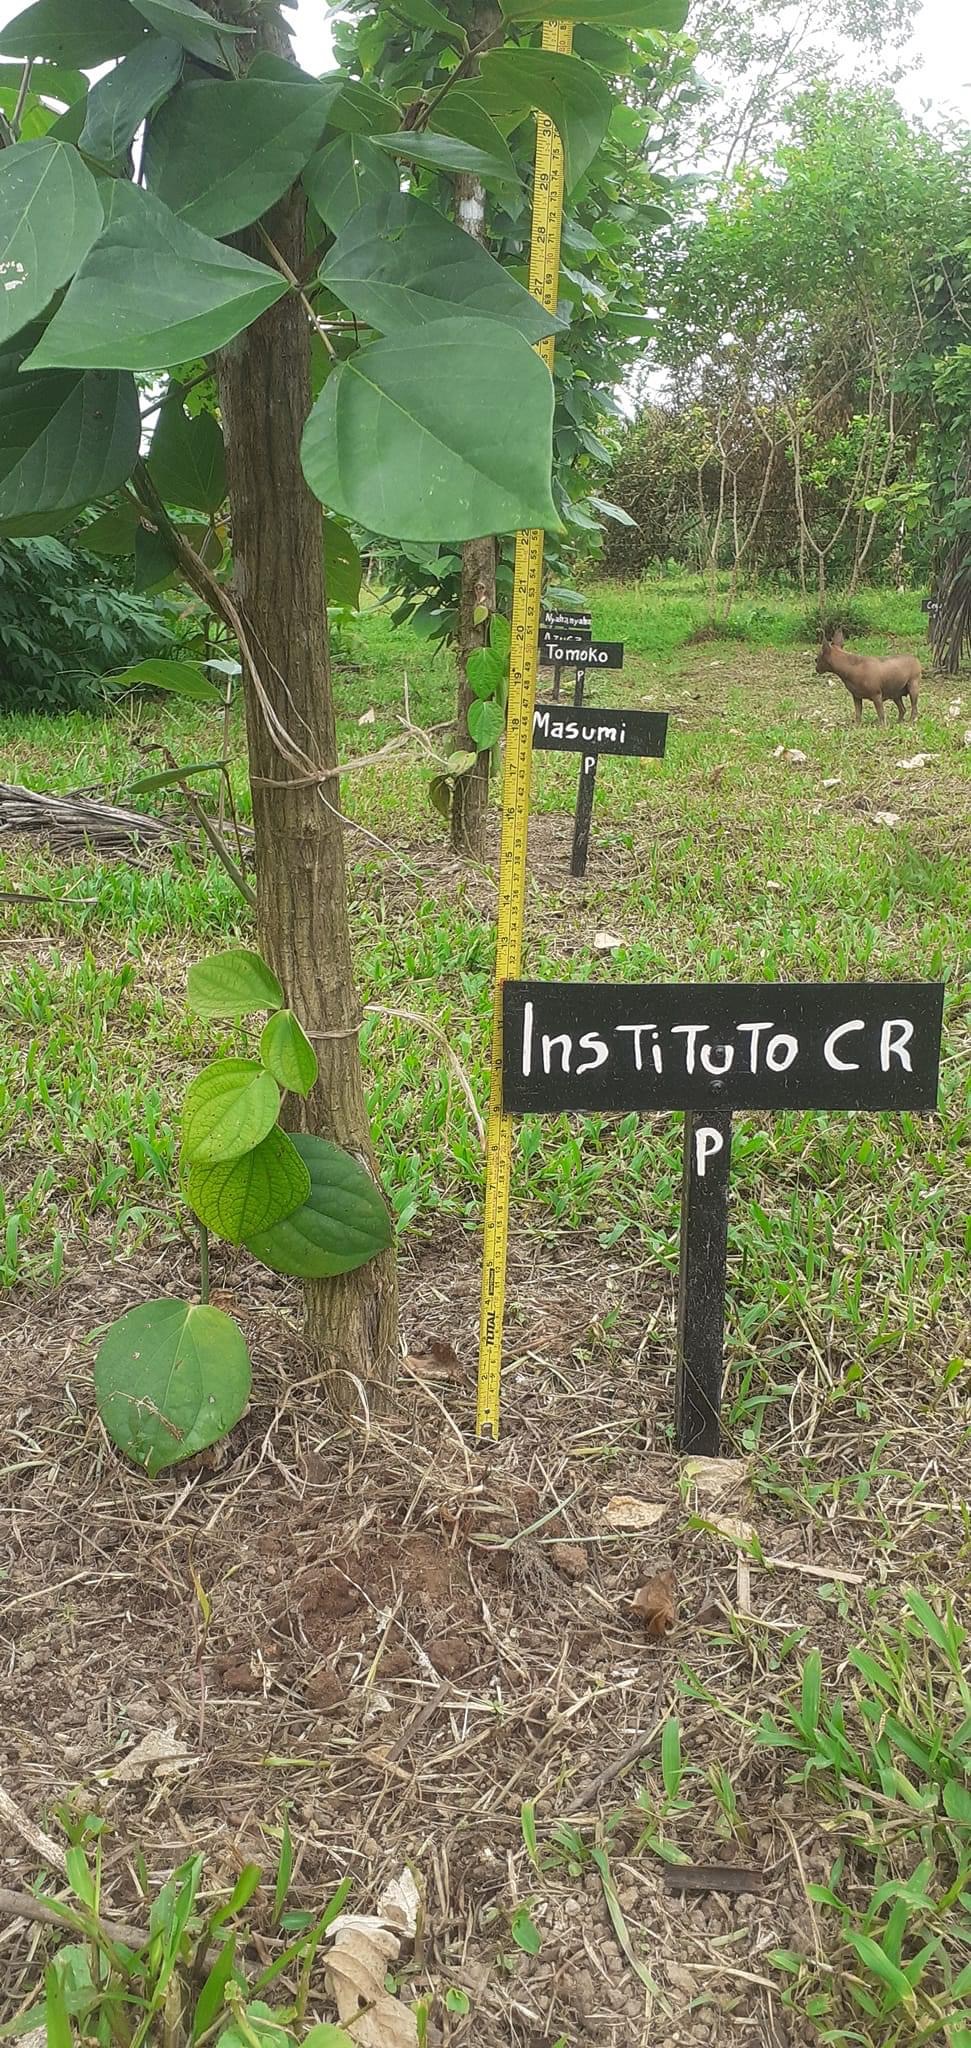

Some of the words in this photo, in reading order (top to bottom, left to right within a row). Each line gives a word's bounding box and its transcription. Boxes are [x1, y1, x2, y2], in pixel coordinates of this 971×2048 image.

[543, 119, 551, 137] 30
[552, 149, 559, 160] 75
[552, 170, 558, 181] 74
[540, 173, 549, 191] 29
[550, 192, 557, 202] 73
[549, 212, 556, 222] 72
[537, 226, 545, 243] 28
[548, 233, 555, 243] 71
[546, 274, 553, 284] 69
[535, 279, 543, 295] 27
[544, 294, 551, 304] 68
[521, 529, 529, 545] 22
[532, 530, 538, 540] 56
[531, 550, 537, 559] 55
[530, 569, 536, 579] 54
[519, 580, 526, 593] 21
[529, 588, 535, 597] 53
[528, 606, 534, 616] 52
[516, 625, 524, 640] 20
[527, 625, 533, 635] 51
[525, 662, 531, 672] 49
[514, 672, 521, 684] 19
[577, 670, 584, 682] P
[524, 680, 530, 690] 48
[523, 699, 529, 708] 47
[512, 718, 519, 731] 18
[522, 716, 528, 726] 46
[533, 711, 626, 743] Masumi
[521, 734, 527, 744] 45
[520, 752, 526, 761] 44
[509, 764, 517, 776] 17
[584, 757, 595, 774] P
[519, 770, 525, 779] 43
[508, 807, 515, 821] 16
[515, 839, 521, 848] 39
[505, 852, 512, 864] 15
[515, 856, 520, 865] 38
[513, 890, 519, 898] 36
[504, 895, 510, 906] 14
[512, 906, 518, 915] 35
[502, 937, 508, 947] 13
[824, 1018, 914, 1073] CR
[495, 1059, 502, 1071] 10
[696, 1127, 723, 1177] P
[486, 1311, 495, 1346] TOTAL
